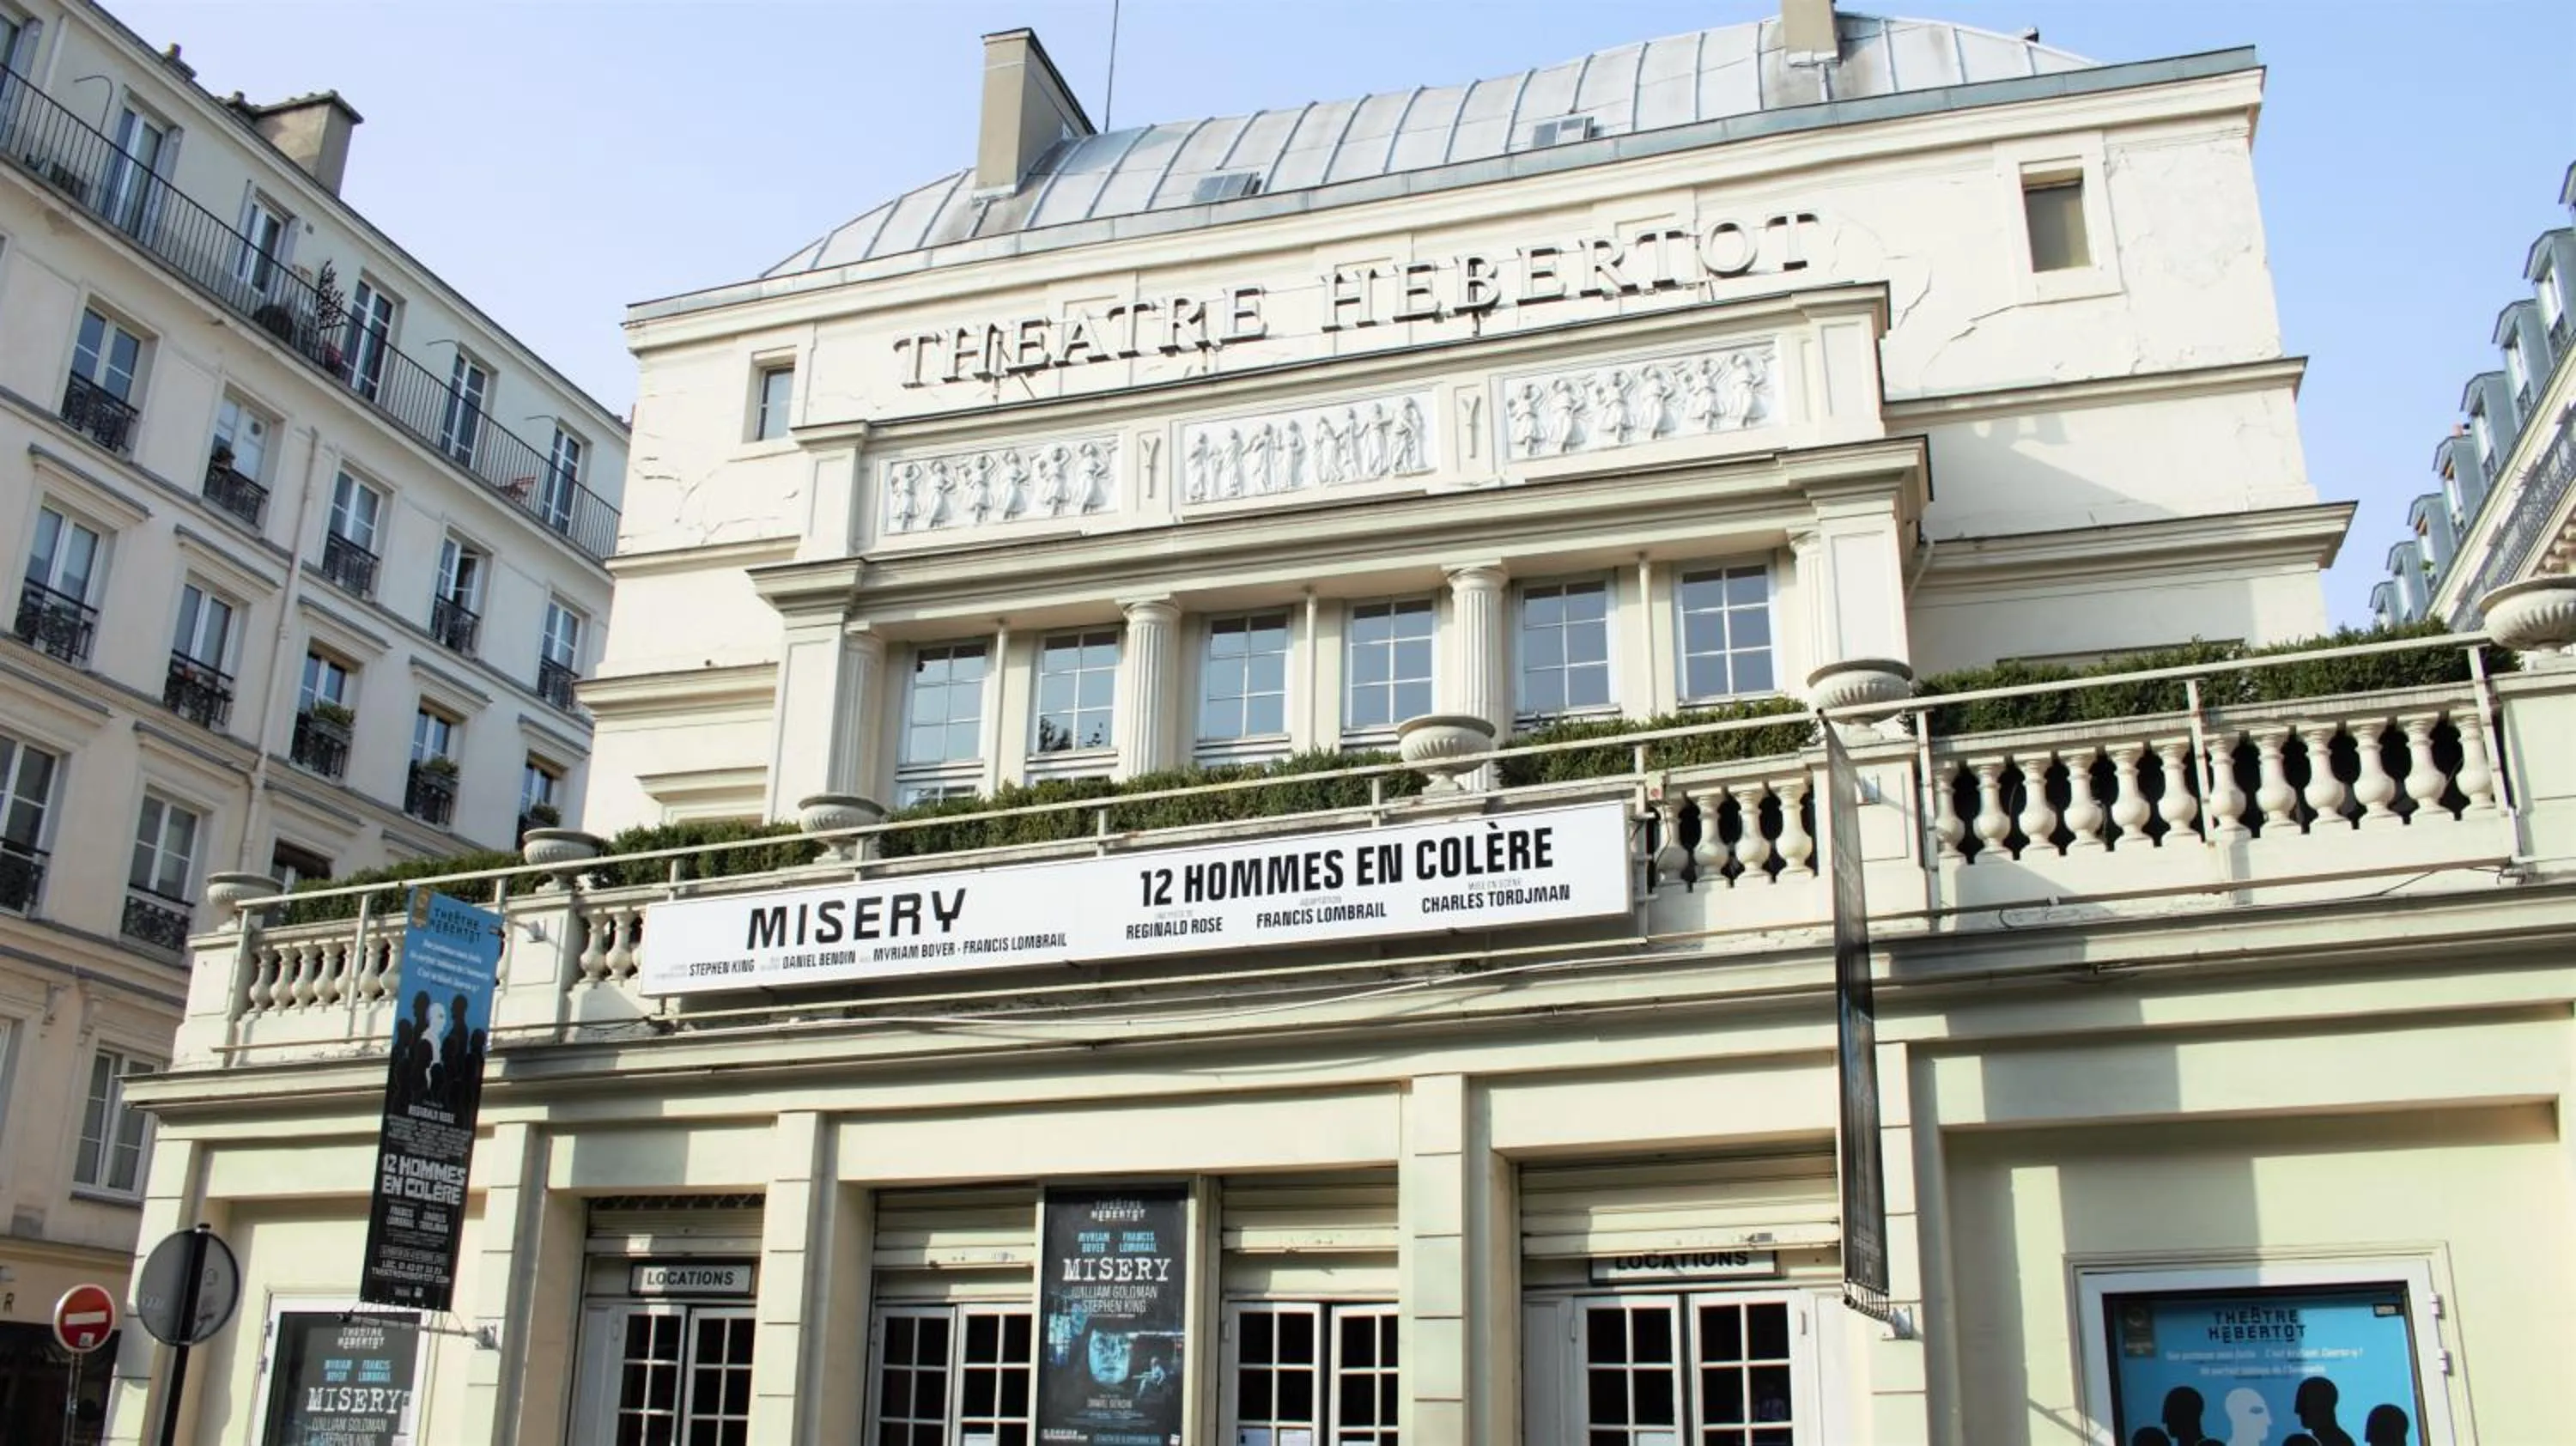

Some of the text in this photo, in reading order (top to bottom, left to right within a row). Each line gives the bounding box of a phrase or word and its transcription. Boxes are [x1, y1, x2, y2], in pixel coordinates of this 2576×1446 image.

[893, 210, 1819, 388] THEATRE HEBERTOT
[1139, 822, 1554, 907] 12 HOMMES EN COLÈRE
[1422, 884, 1571, 914] CHARLES TORDJMAN
[747, 888, 967, 951] MISERY
[1256, 902, 1387, 928] FRANCIS LOMBRAIL
[1126, 917, 1224, 940] REGINALD ROSE
[690, 961, 730, 976] STEPHEN
[732, 959, 755, 974] KING
[782, 954, 817, 969] DANIEL
[873, 944, 920, 962] MYRIAM
[921, 942, 956, 957] BOYER
[963, 937, 1010, 955] FRANCIS
[1011, 933, 1067, 951] LOMBRAIL
[383, 1153, 466, 1186] 12 HOMMES
[381, 1174, 403, 1195] EN
[1062, 1257, 1172, 1282] MISERY
[1615, 1251, 1749, 1270] LOCATIONS
[647, 1271, 734, 1285] LOCATIONS
[1113, 1285, 1157, 1299] GOLDMAN
[1082, 1299, 1146, 1313] STEPHEN KING
[307, 1387, 402, 1414] MISERY
